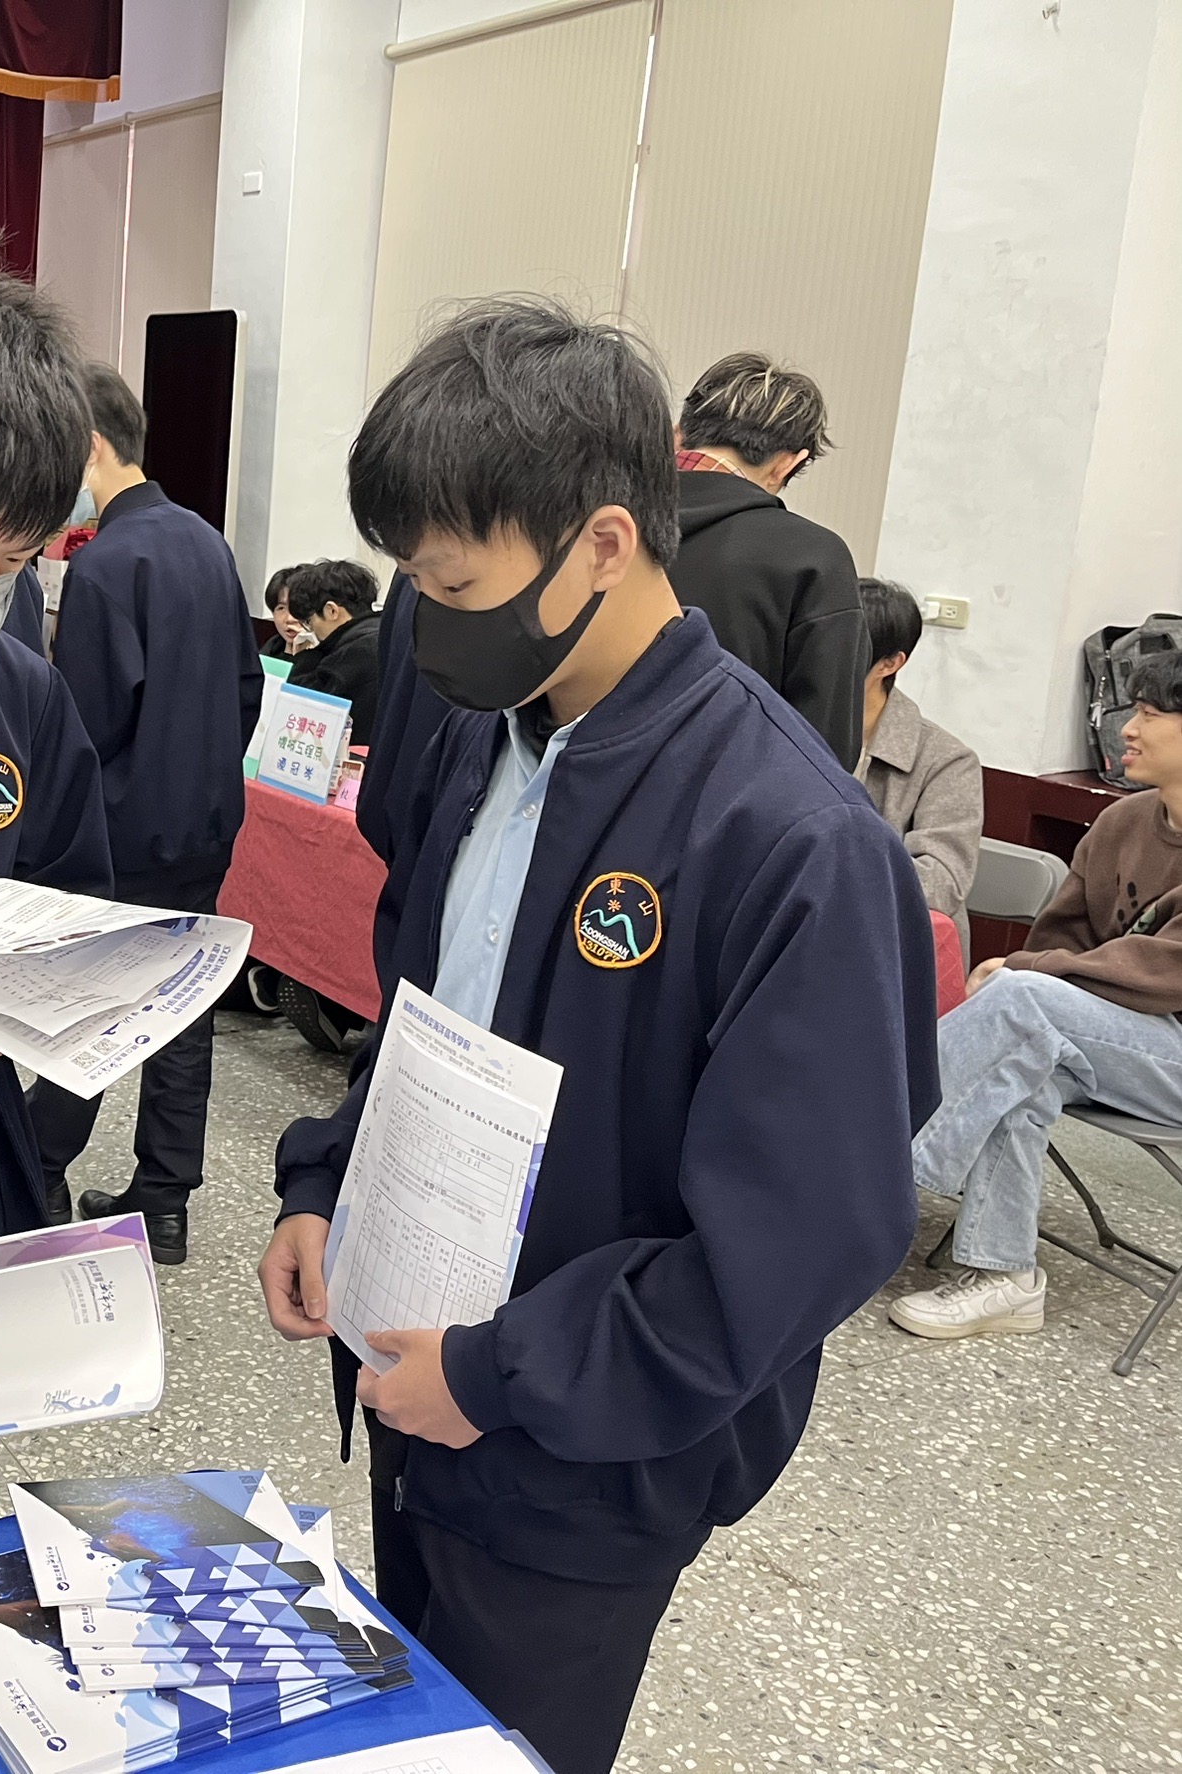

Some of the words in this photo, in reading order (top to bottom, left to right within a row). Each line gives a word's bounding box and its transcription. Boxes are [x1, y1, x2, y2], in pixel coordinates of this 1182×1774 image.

[285, 713, 327, 739] 台灣大學
[606, 877, 626, 896] 東
[638, 900, 654, 917] 山
[586, 926, 630, 957] DONGSHAN
